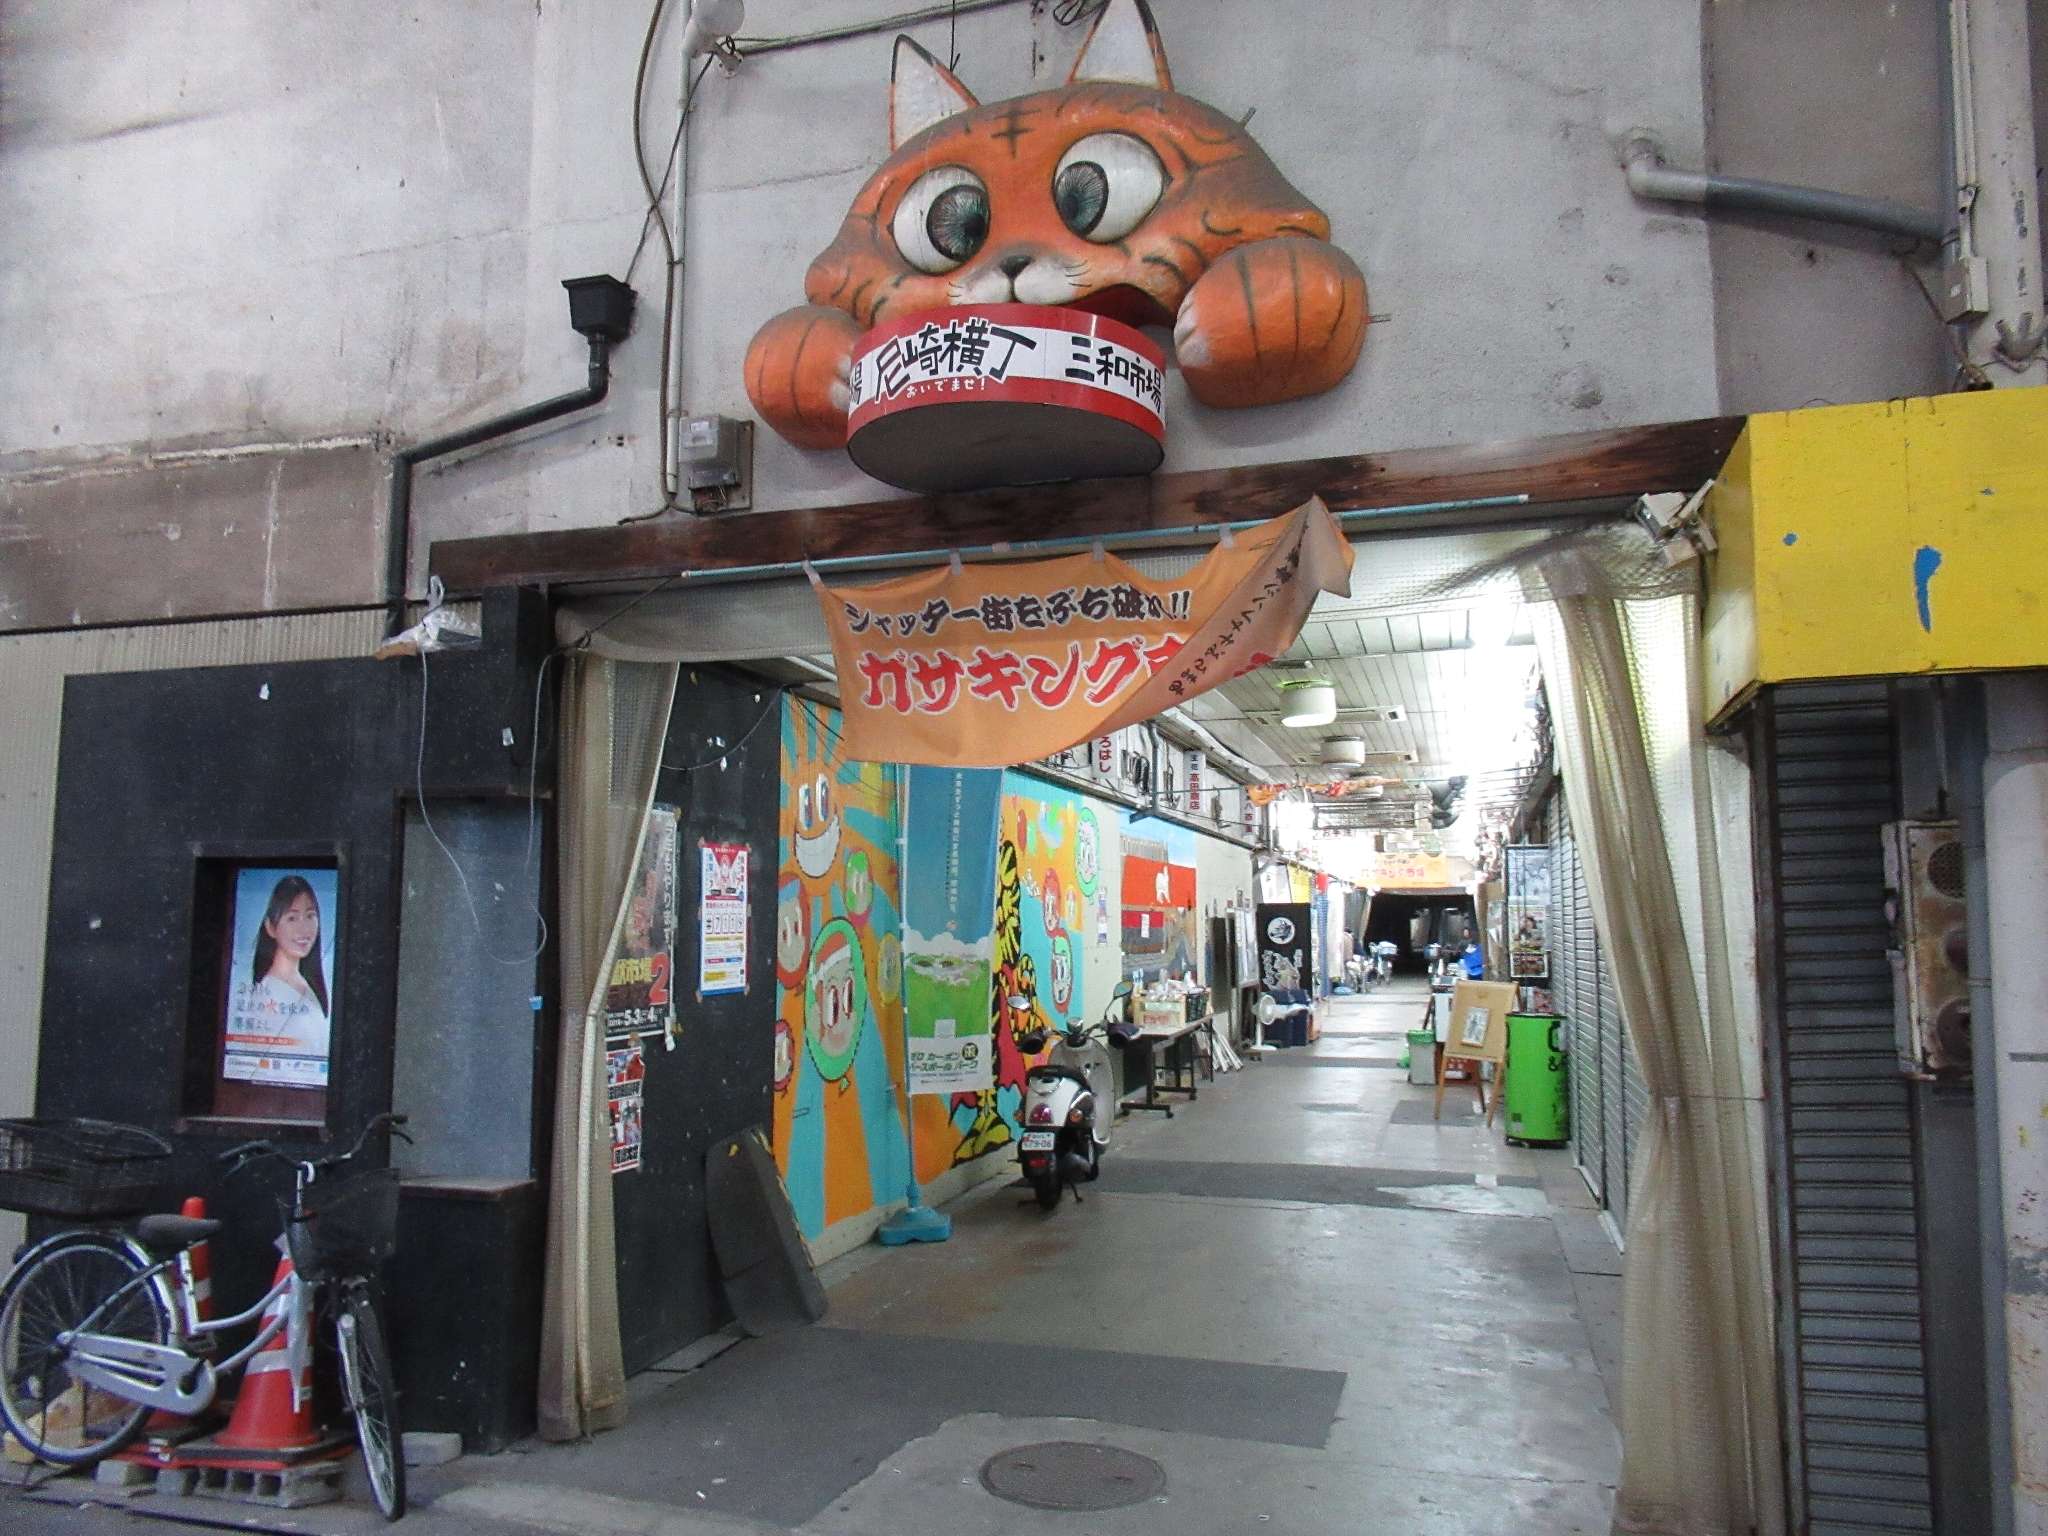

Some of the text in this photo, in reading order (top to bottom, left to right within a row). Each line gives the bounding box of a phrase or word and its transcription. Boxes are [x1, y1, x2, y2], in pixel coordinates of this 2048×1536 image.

[874, 317, 1037, 404] 尼崎横丁
[905, 377, 987, 399] おいでませ!
[1064, 335, 1163, 414] 三和市場
[843, 585, 1191, 637] シャッター街をぶち破れ!!
